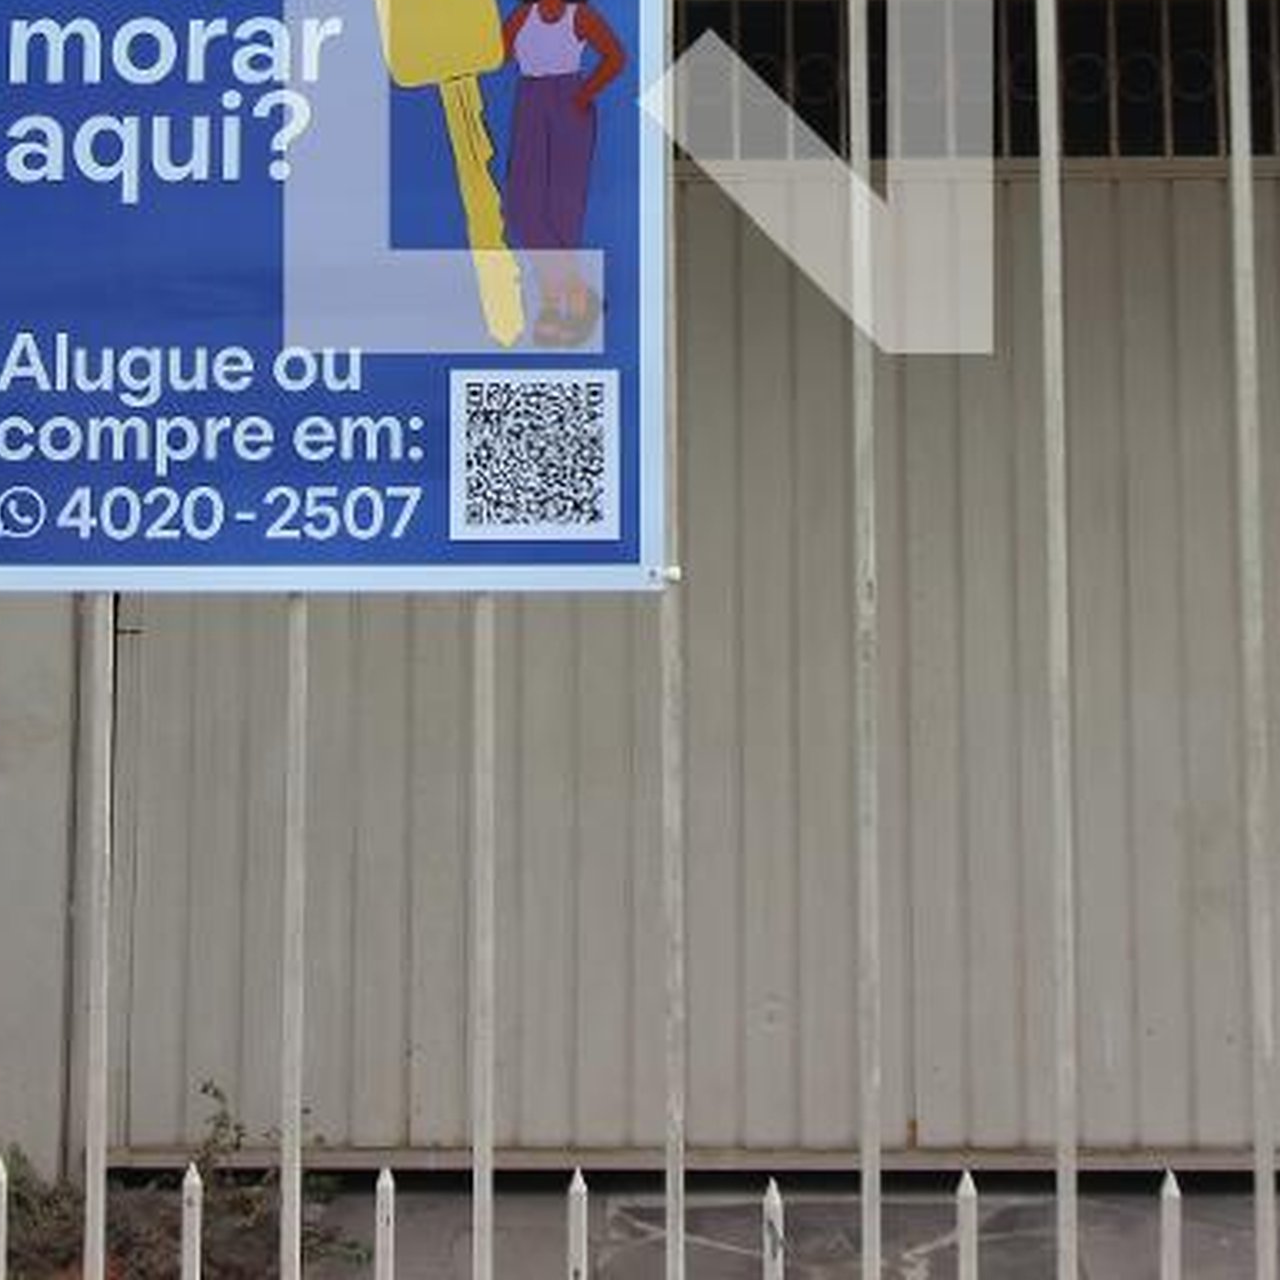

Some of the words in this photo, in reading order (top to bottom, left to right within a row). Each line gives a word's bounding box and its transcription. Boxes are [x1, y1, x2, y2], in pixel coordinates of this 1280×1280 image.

[8, 16, 343, 84] morar
[5, 90, 312, 204] aqui?
[272, 347, 362, 392] ou
[293, 415, 424, 462] em:
